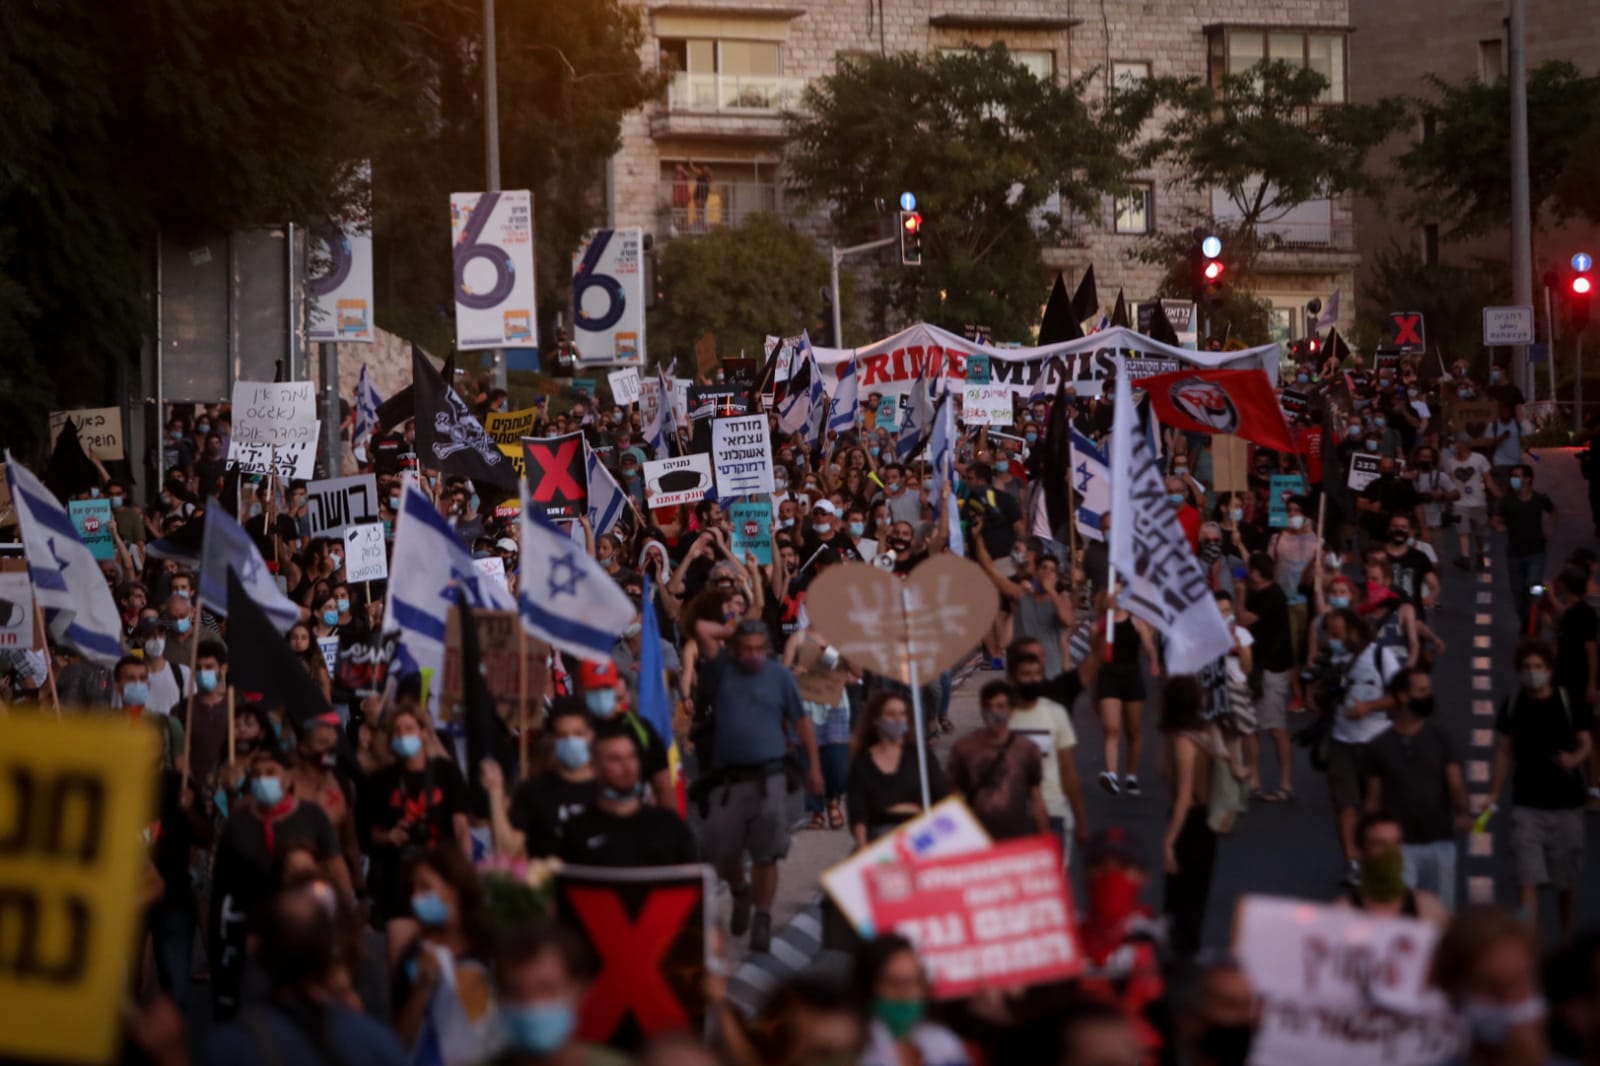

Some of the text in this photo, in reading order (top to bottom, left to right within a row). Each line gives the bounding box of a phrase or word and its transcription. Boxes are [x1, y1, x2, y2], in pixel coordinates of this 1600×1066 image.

[836, 346, 970, 386] CRIME
[726, 420, 762, 433] מזרחי
[723, 434, 763, 447] עצמאי
[719, 447, 765, 461] אשקלוני
[663, 459, 691, 470] נתניהו
[718, 460, 766, 475] דמוקרטי
[656, 495, 681, 505] אותנו
[308, 484, 378, 532] בושה
